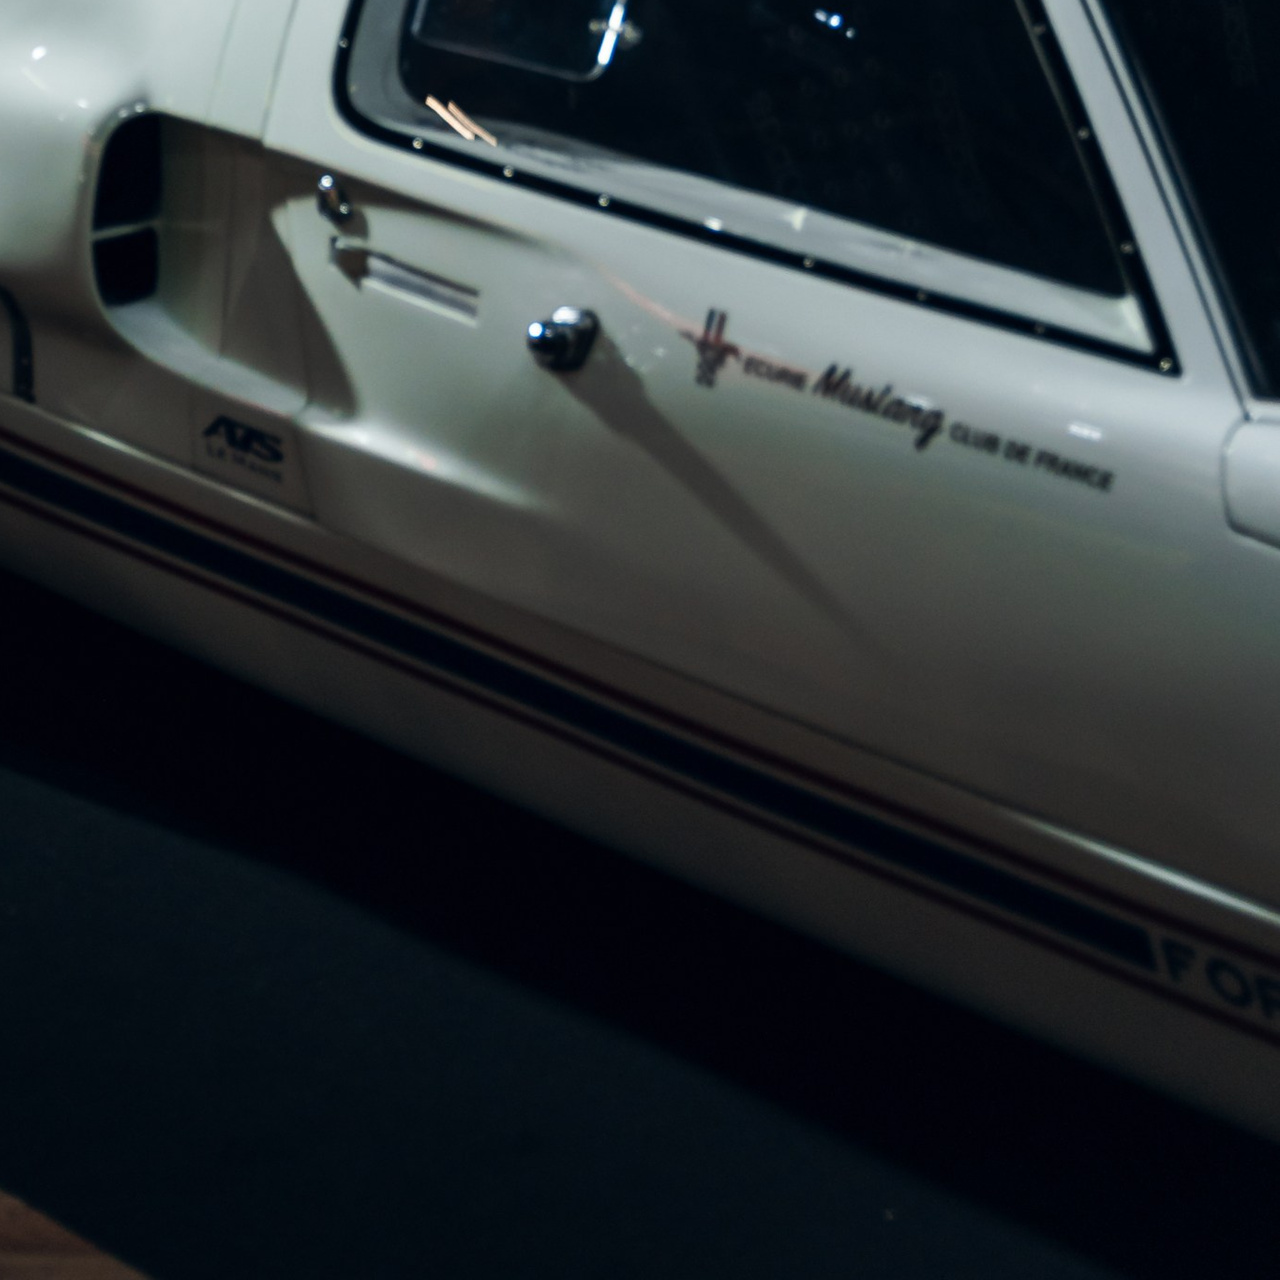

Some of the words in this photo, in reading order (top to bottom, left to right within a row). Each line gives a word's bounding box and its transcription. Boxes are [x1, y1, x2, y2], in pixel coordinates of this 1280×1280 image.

[812, 362, 945, 452] Mustang
[949, 420, 1001, 456] CLUB
[1003, 440, 1032, 466] DE
[1034, 448, 1117, 494] FRANCE
